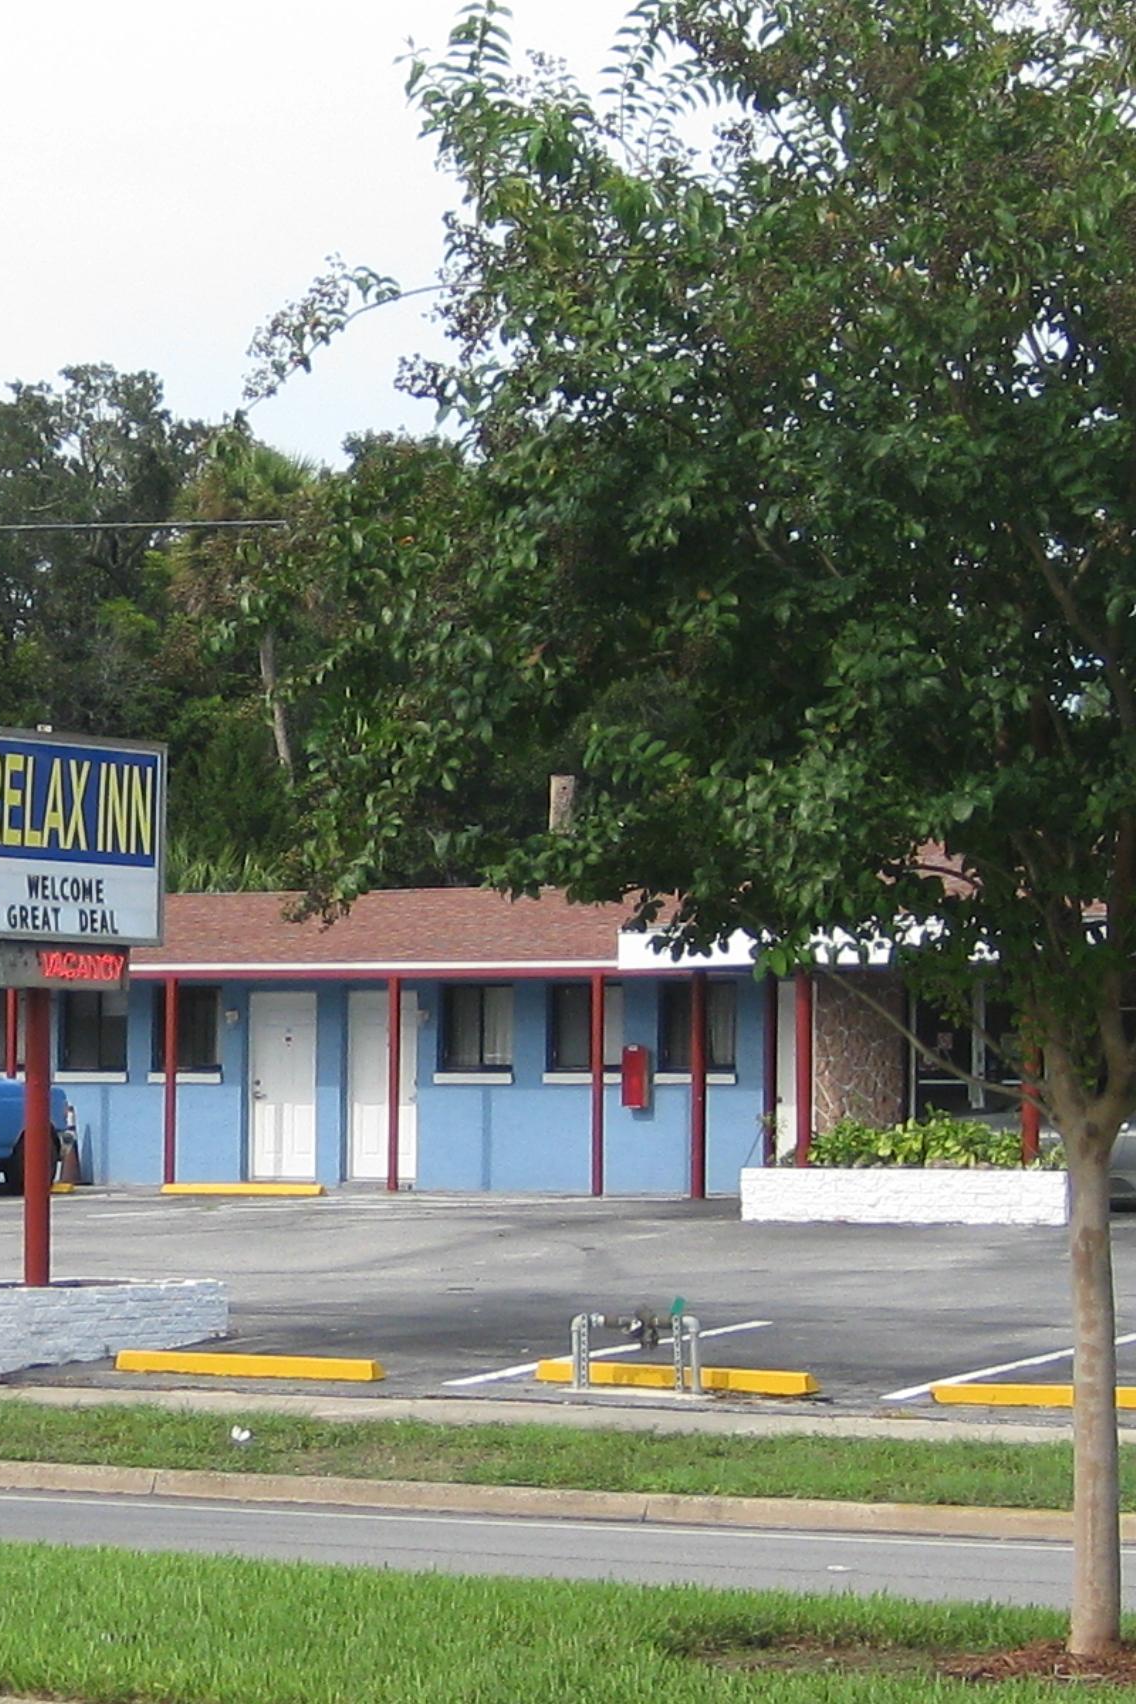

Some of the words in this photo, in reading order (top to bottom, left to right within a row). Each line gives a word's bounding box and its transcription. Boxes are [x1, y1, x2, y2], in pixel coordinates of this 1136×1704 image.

[97, 762, 153, 855] INN
[27, 875, 105, 904] WELCOME
[7, 905, 61, 932] GREAT
[79, 910, 119, 934] DEAL
[40, 952, 125, 980] VACANCY
